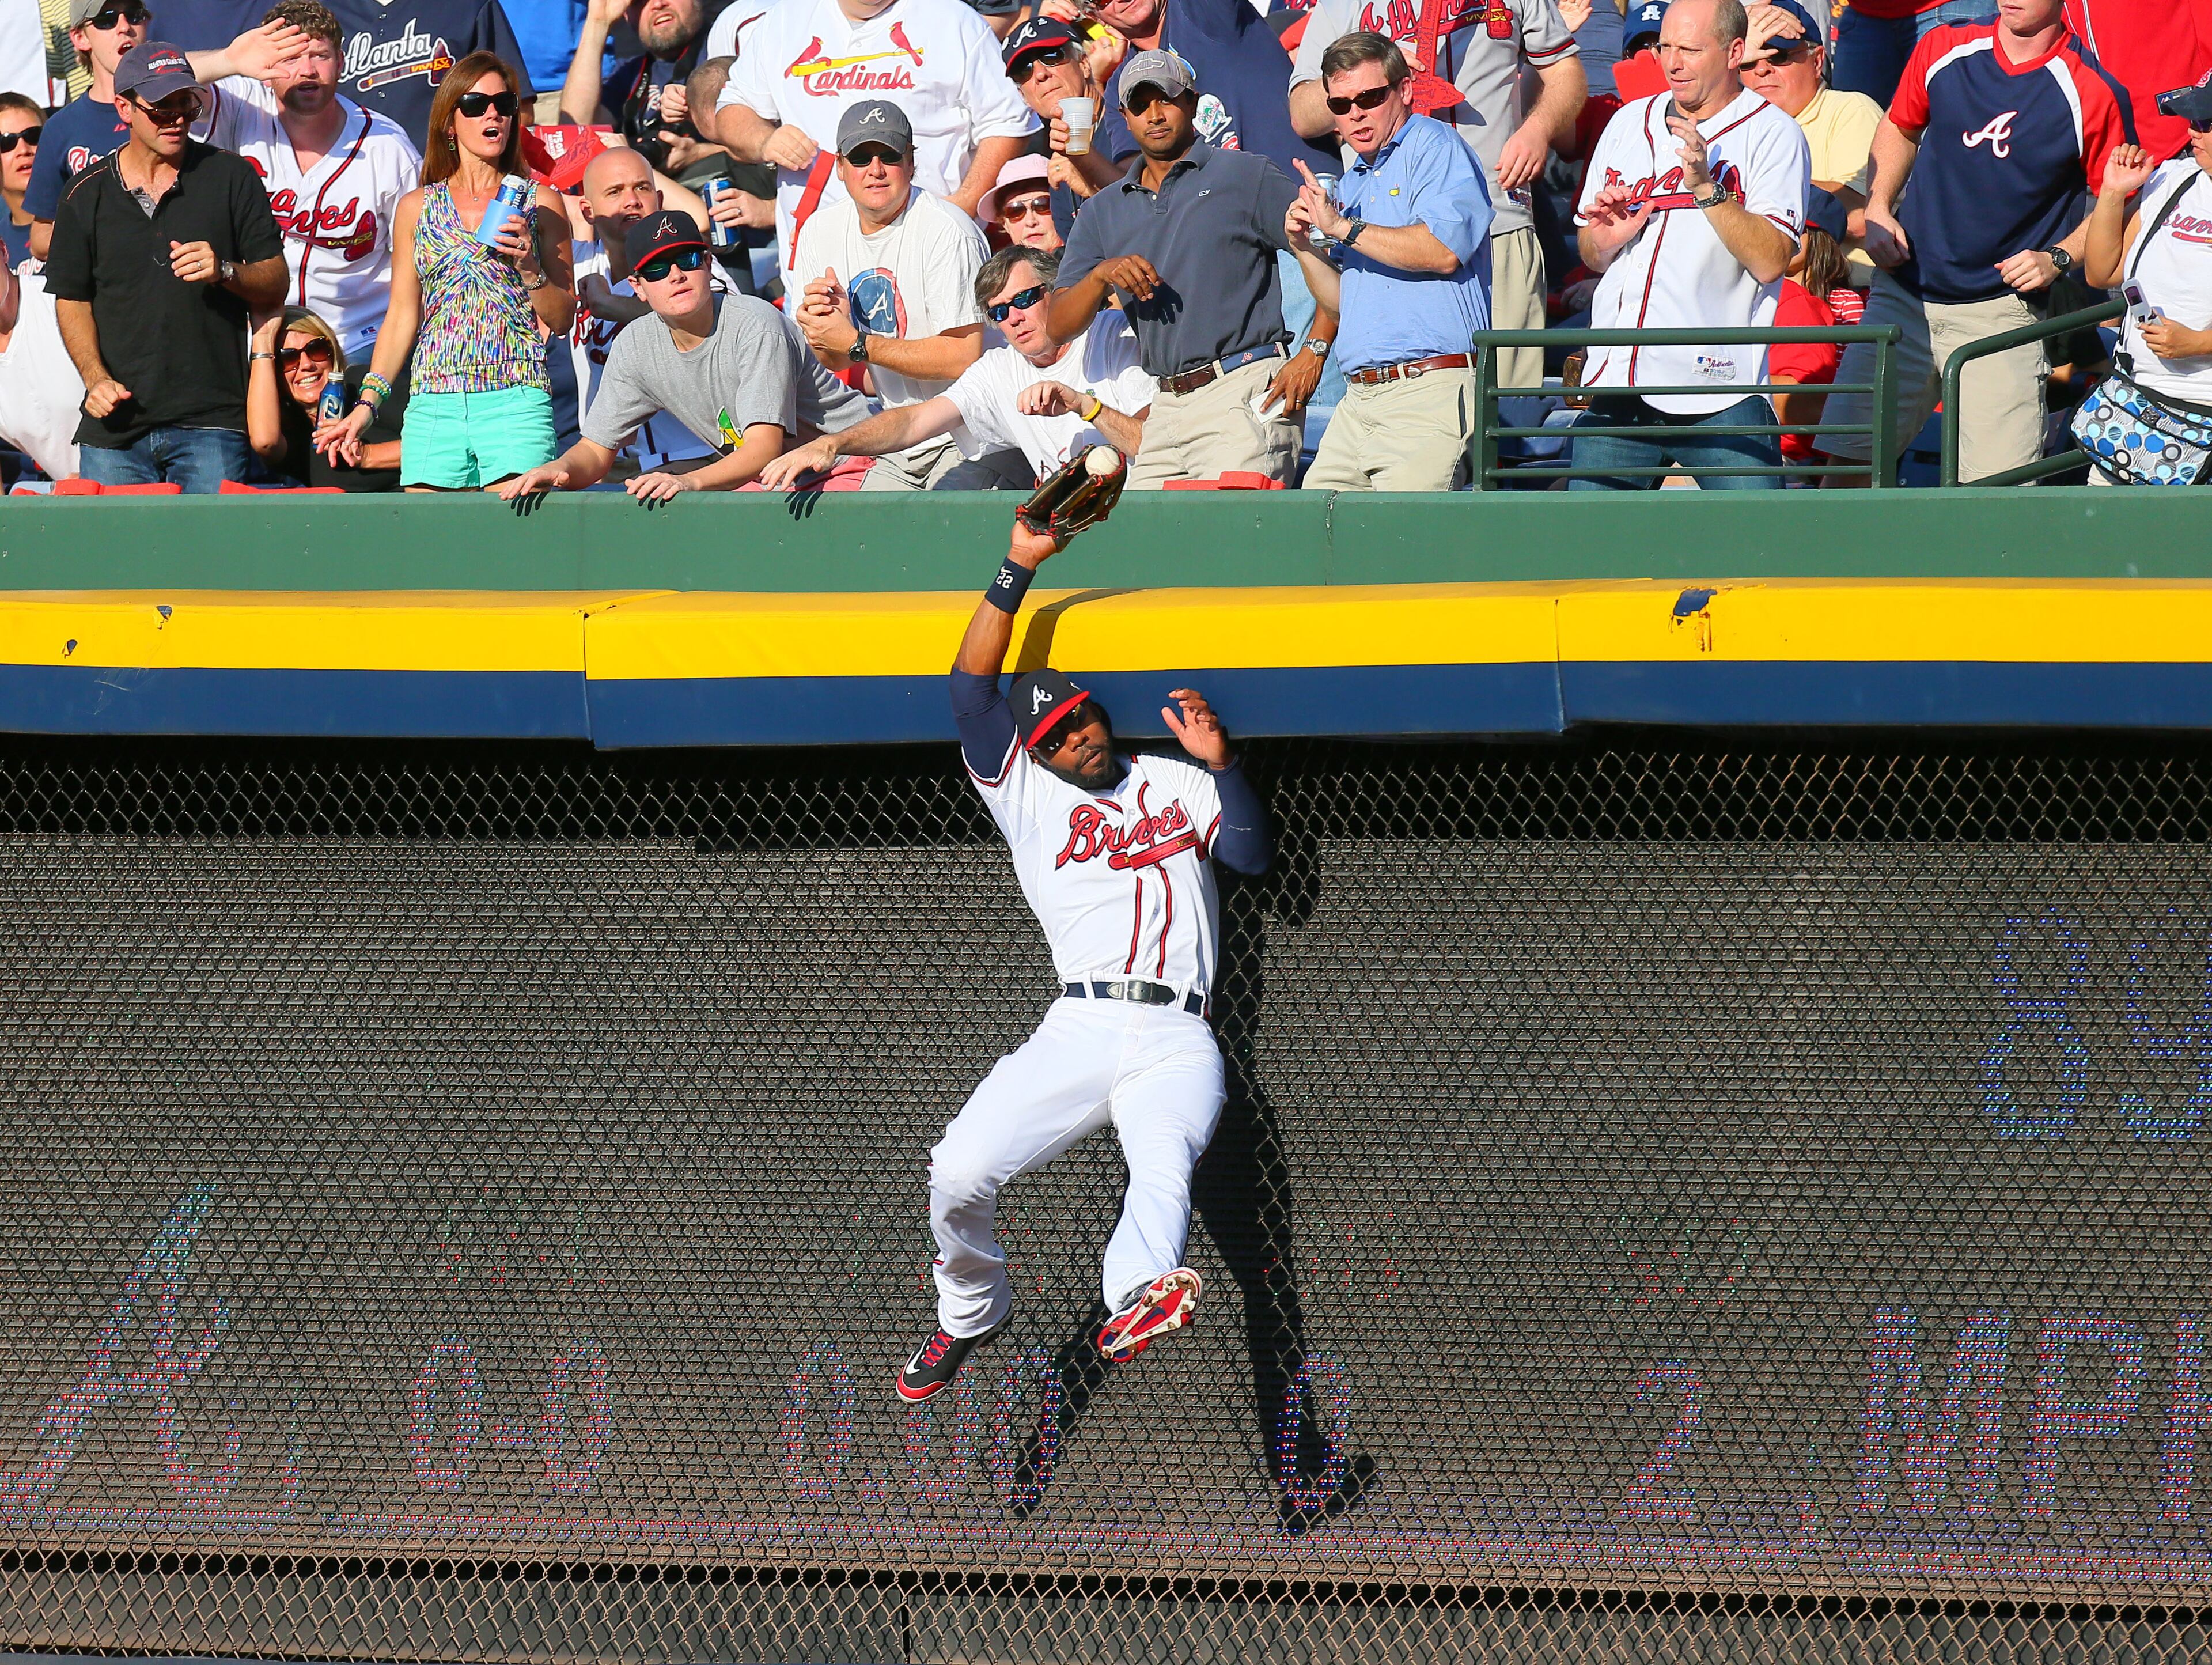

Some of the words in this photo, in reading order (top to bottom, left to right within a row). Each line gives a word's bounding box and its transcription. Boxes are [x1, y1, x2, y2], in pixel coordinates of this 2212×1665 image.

[336, 17, 432, 83] tlanta
[1013, 22, 1037, 48] A
[803, 57, 915, 97] Cardinals
[859, 108, 885, 124] A
[1961, 110, 2018, 159] A
[652, 215, 678, 241] A
[862, 286, 893, 321] A
[995, 572, 1014, 589] 22
[1031, 684, 1054, 716] A
[1615, 1359, 1704, 1520] 2
